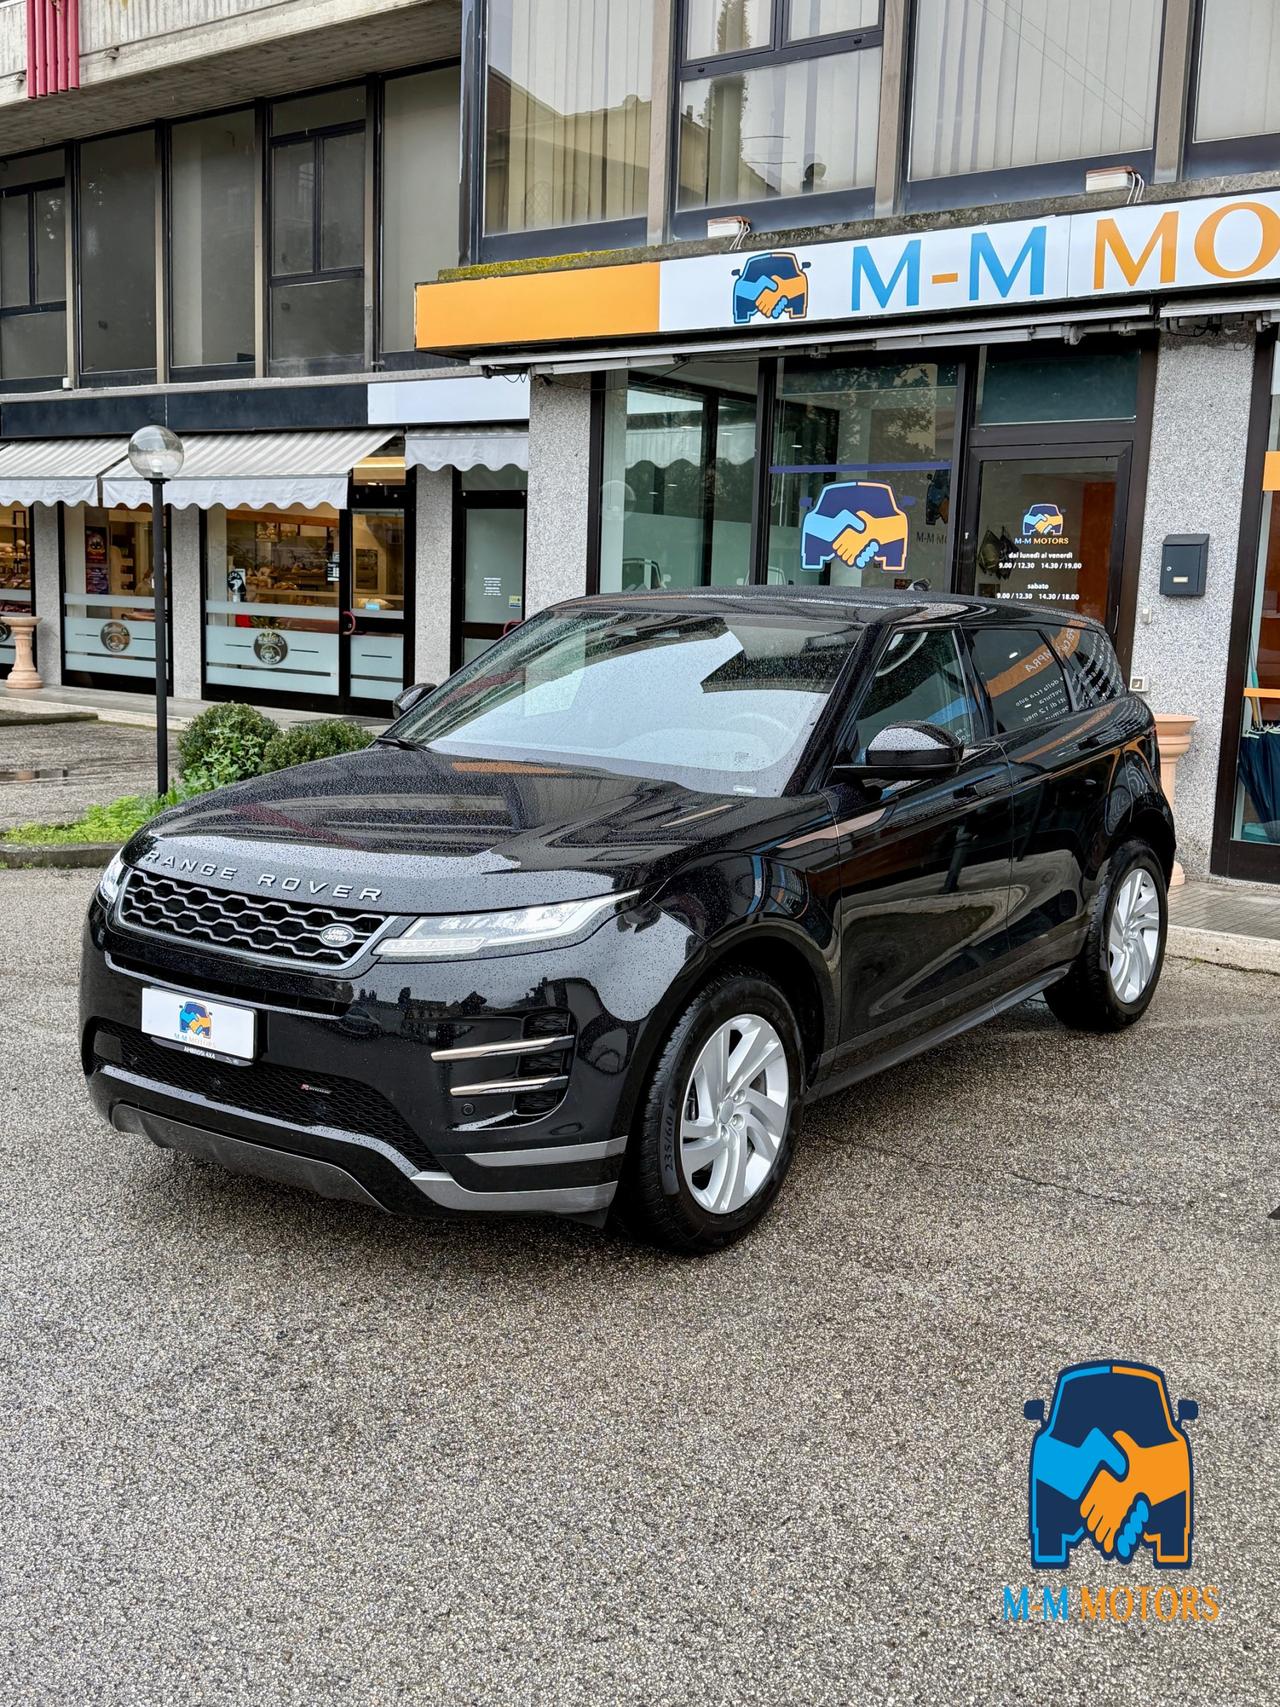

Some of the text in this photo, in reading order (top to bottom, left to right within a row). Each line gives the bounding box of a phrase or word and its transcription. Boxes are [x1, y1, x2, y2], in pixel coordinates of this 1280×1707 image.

[851, 201, 1280, 311] M-M MO
[996, 592, 1011, 600] 9.00
[1015, 592, 1033, 600] 12.30
[1038, 592, 1056, 600] 14.30
[1027, 582, 1049, 590] sabato
[144, 850, 383, 902] RANGE ROVER
